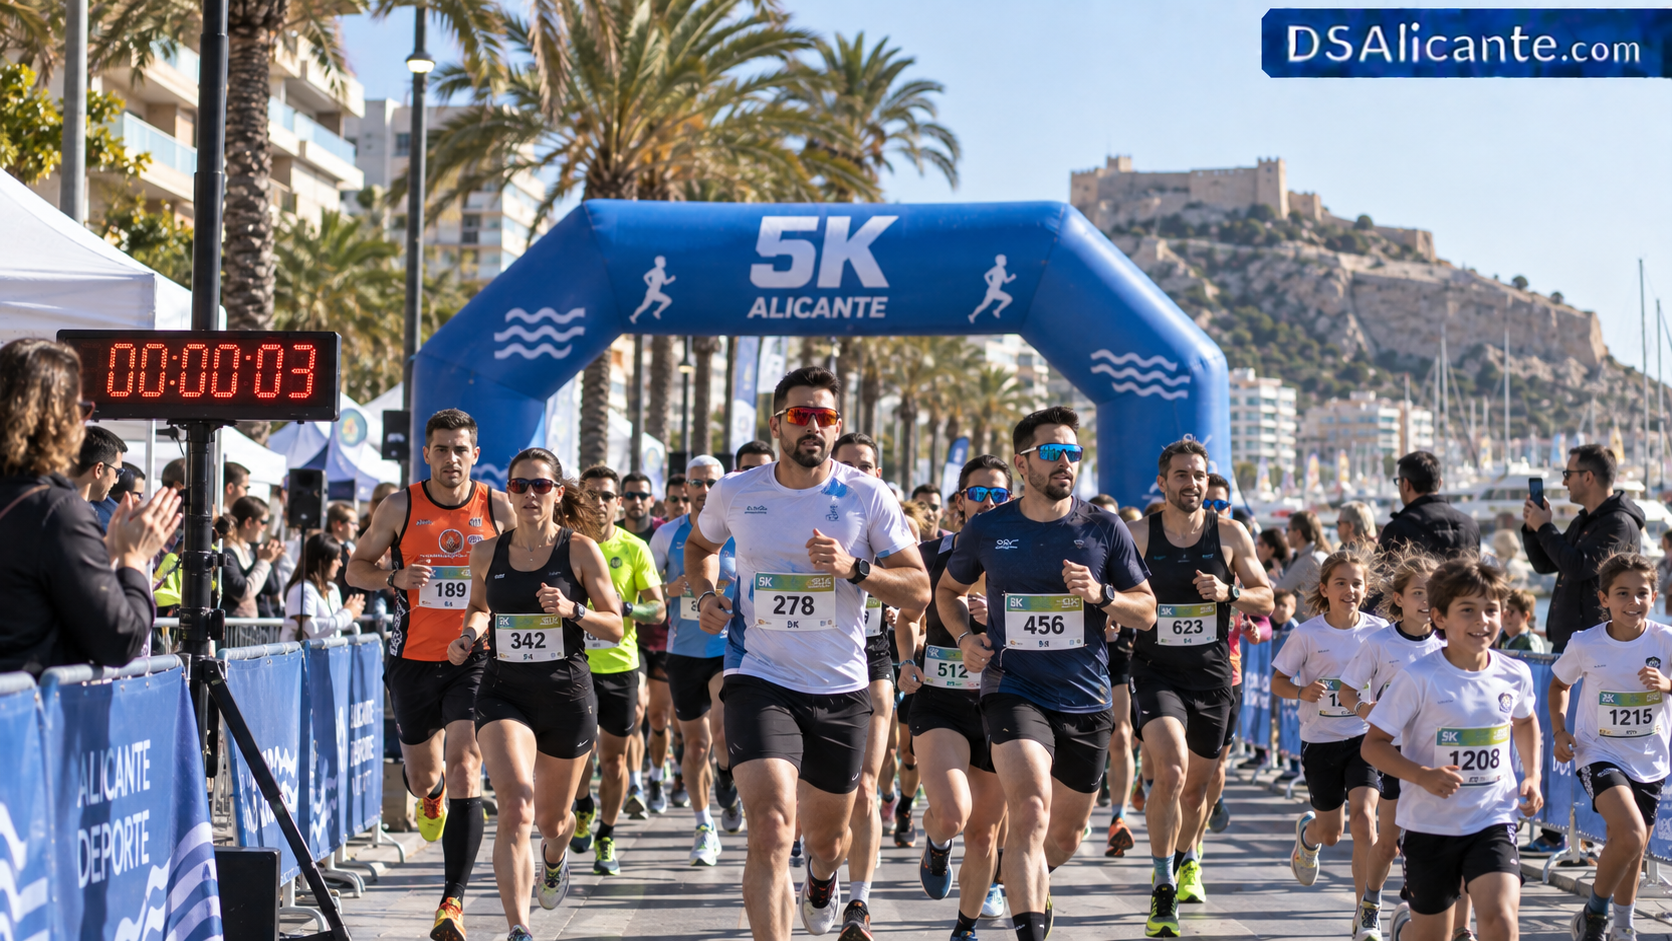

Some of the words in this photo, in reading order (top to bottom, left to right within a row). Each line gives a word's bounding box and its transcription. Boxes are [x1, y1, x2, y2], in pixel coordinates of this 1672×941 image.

[749, 215, 899, 289] 5K
[746, 296, 889, 319] ALICANTE
[107, 343, 316, 398] 00:00:03
[435, 582, 466, 598] 189
[773, 594, 815, 616] 278
[1023, 615, 1065, 635] 456
[1172, 619, 1204, 635] 623
[510, 631, 547, 650] 342
[937, 662, 969, 679] 512
[1609, 708, 1653, 726] 1215
[1449, 748, 1500, 771] 1208
[77, 739, 151, 808] ALICANTE
[77, 809, 150, 889] DEPORTE
